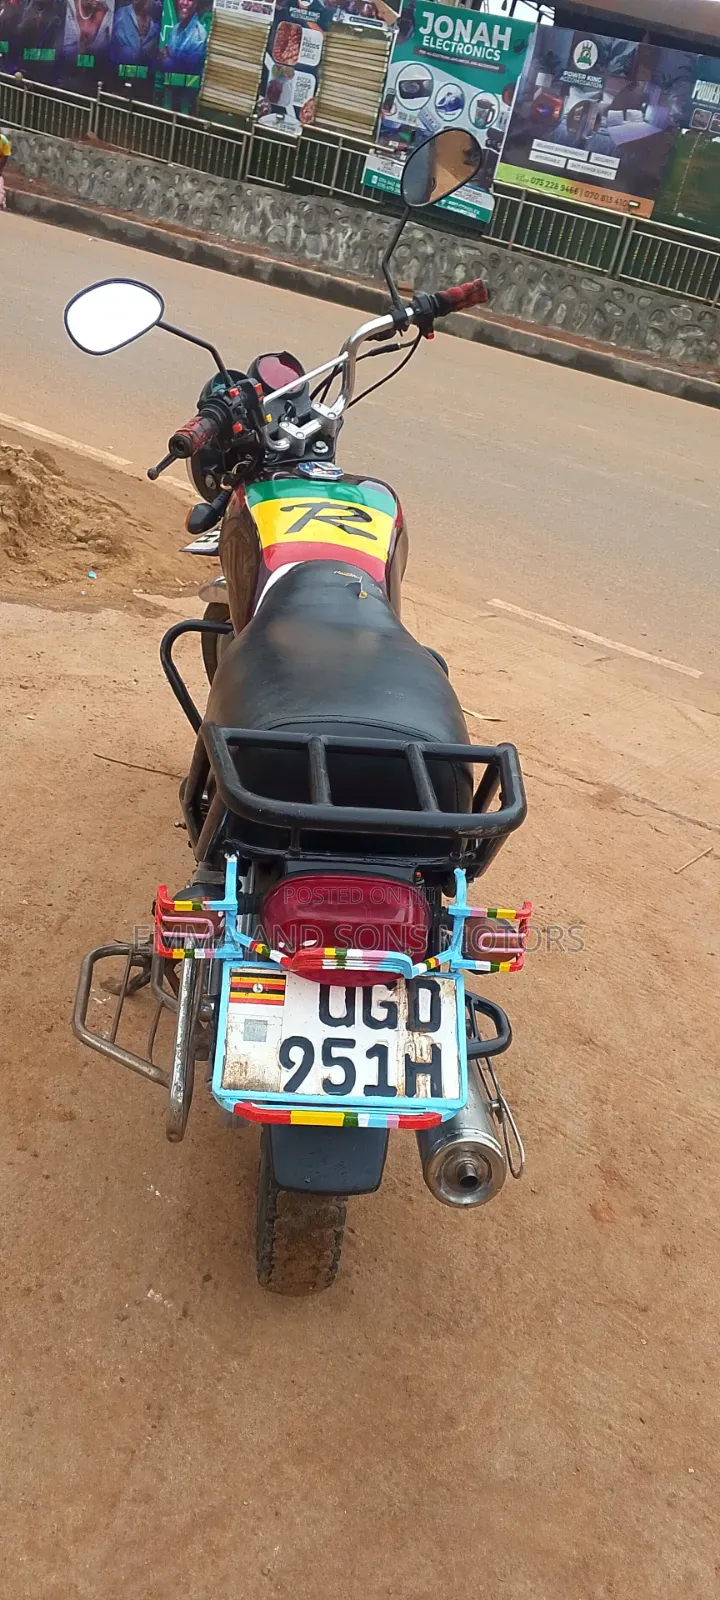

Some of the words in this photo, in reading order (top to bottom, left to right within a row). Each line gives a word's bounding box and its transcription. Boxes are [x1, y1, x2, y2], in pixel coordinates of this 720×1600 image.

[419, 11, 512, 51] JONAH
[422, 35, 501, 61] ELECTRONICS
[563, 70, 587, 80] POWER
[587, 75, 602, 83] KING
[530, 176, 545, 187] 075
[544, 180, 560, 191] 228
[584, 190, 600, 200] 070
[279, 501, 378, 541] R
[319, 979, 442, 1034] UGD
[279, 1035, 444, 1098] 951H
